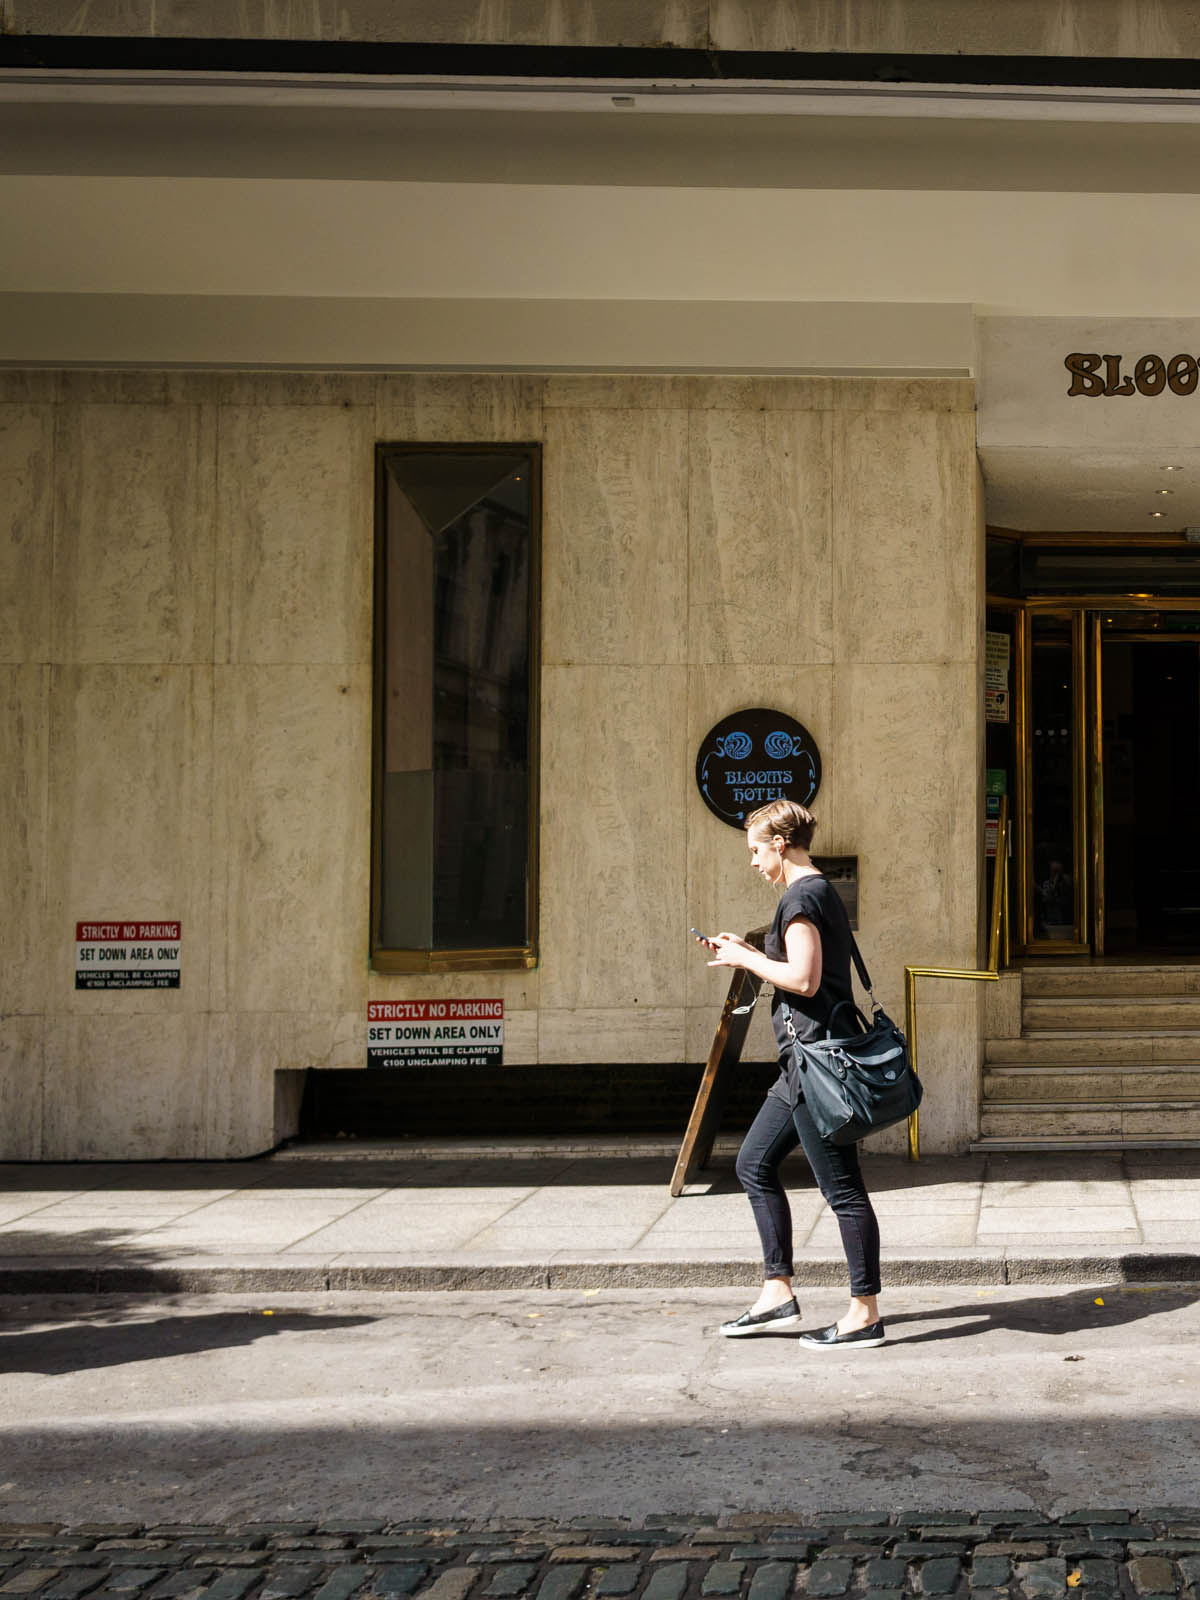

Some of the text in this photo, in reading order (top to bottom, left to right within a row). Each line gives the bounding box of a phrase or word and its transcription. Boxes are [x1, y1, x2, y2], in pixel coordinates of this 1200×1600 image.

[724, 770, 793, 785] BLOOMS
[732, 787, 787, 804] HOTEL
[82, 925, 177, 938] STRICTLY NO PARKING
[80, 948, 179, 961] SET DOWN AREA ONLY
[369, 1003, 501, 1018] STRICTLY NO PARKING
[369, 1026, 501, 1040] SET DOWN AREA ONLY
[371, 1048, 415, 1056] VEHICLES
[384, 1059, 404, 1067] €100
[407, 1058, 467, 1066] UNCLAMPING
